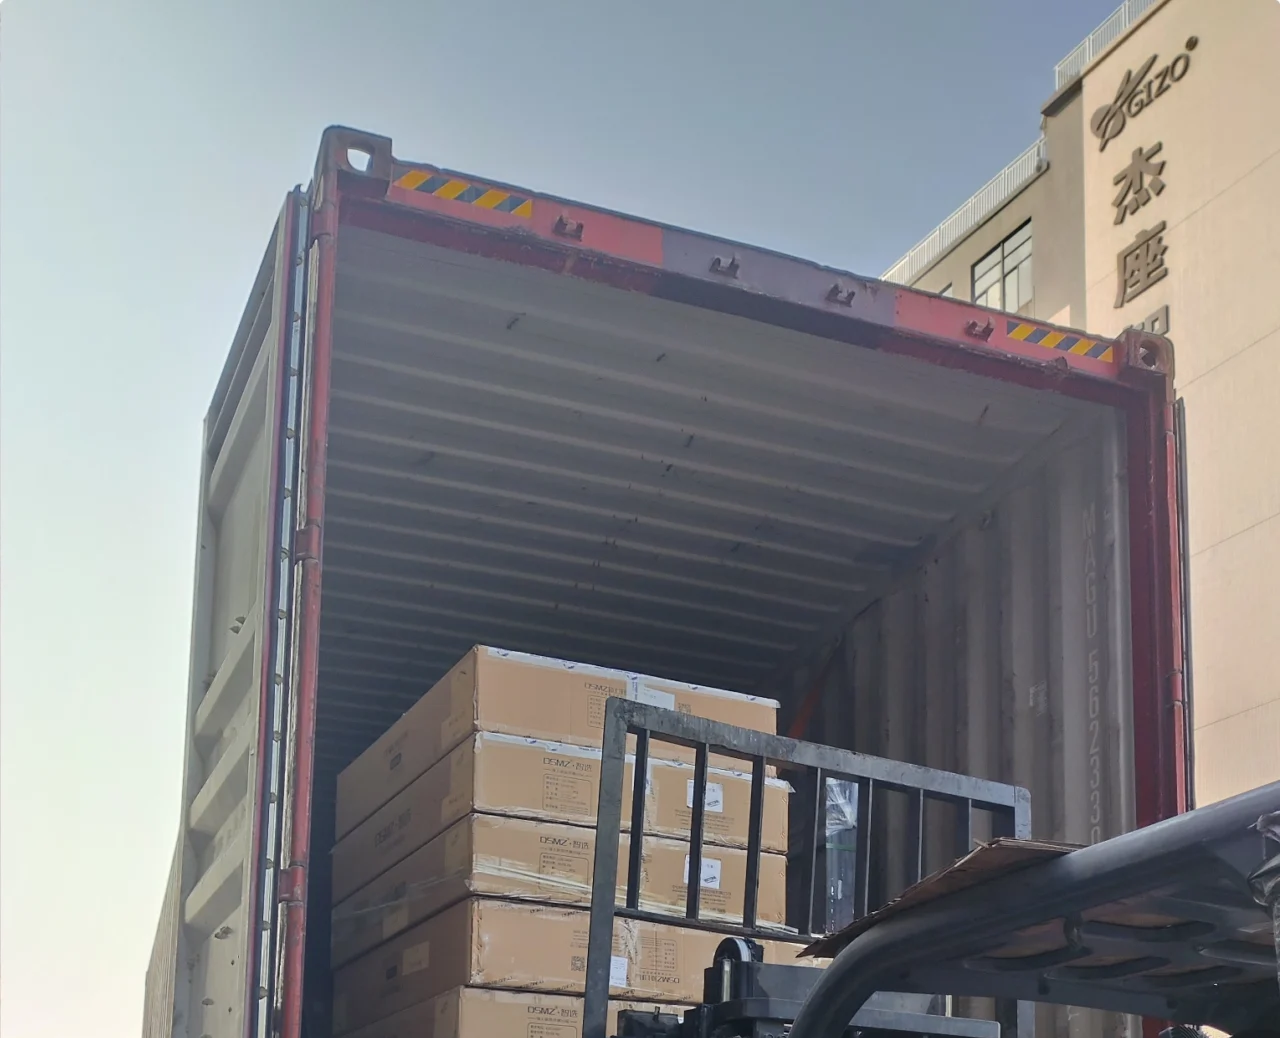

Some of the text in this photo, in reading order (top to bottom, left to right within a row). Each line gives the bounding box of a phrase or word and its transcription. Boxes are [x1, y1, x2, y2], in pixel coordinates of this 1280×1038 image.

[1127, 53, 1191, 118] GIZO
[543, 757, 570, 768] DSMZ
[540, 836, 567, 846] DSMZ
[527, 1006, 556, 1015] DSMZ
